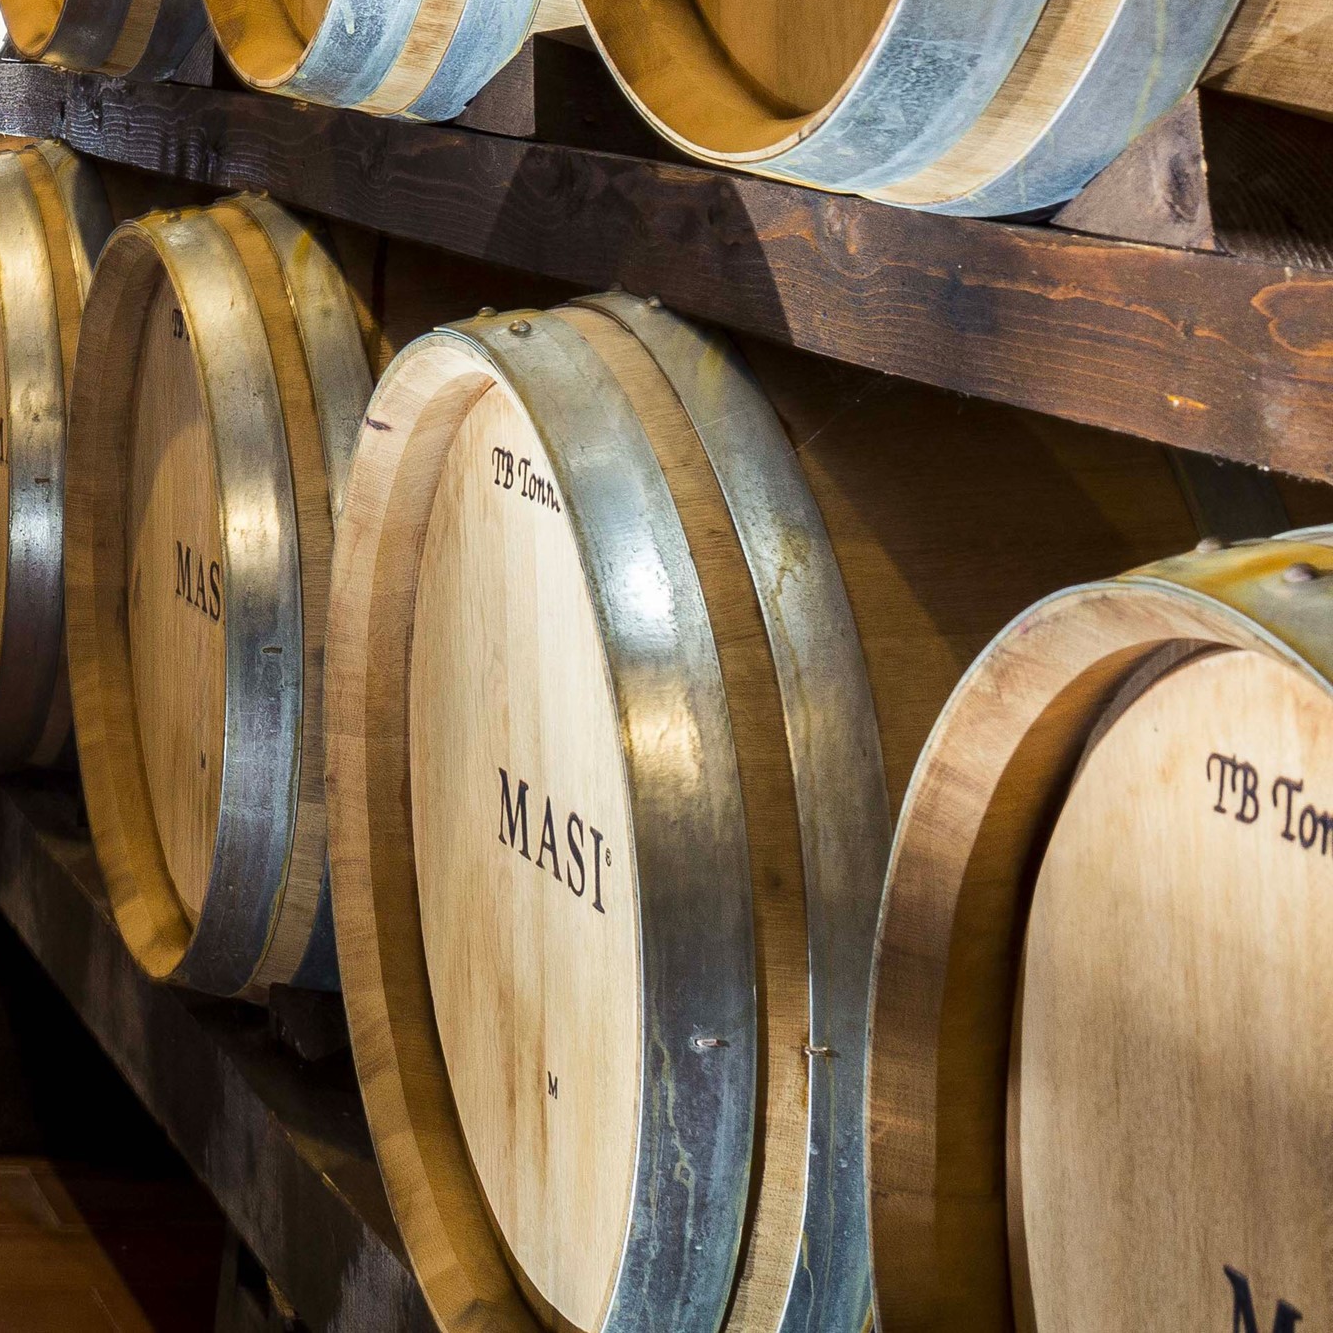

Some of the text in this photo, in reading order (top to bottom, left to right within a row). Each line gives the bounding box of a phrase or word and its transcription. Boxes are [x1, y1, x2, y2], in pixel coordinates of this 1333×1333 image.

[492, 447, 514, 490] TB
[1207, 753, 1259, 824] TB
[547, 1070, 558, 1100] M
